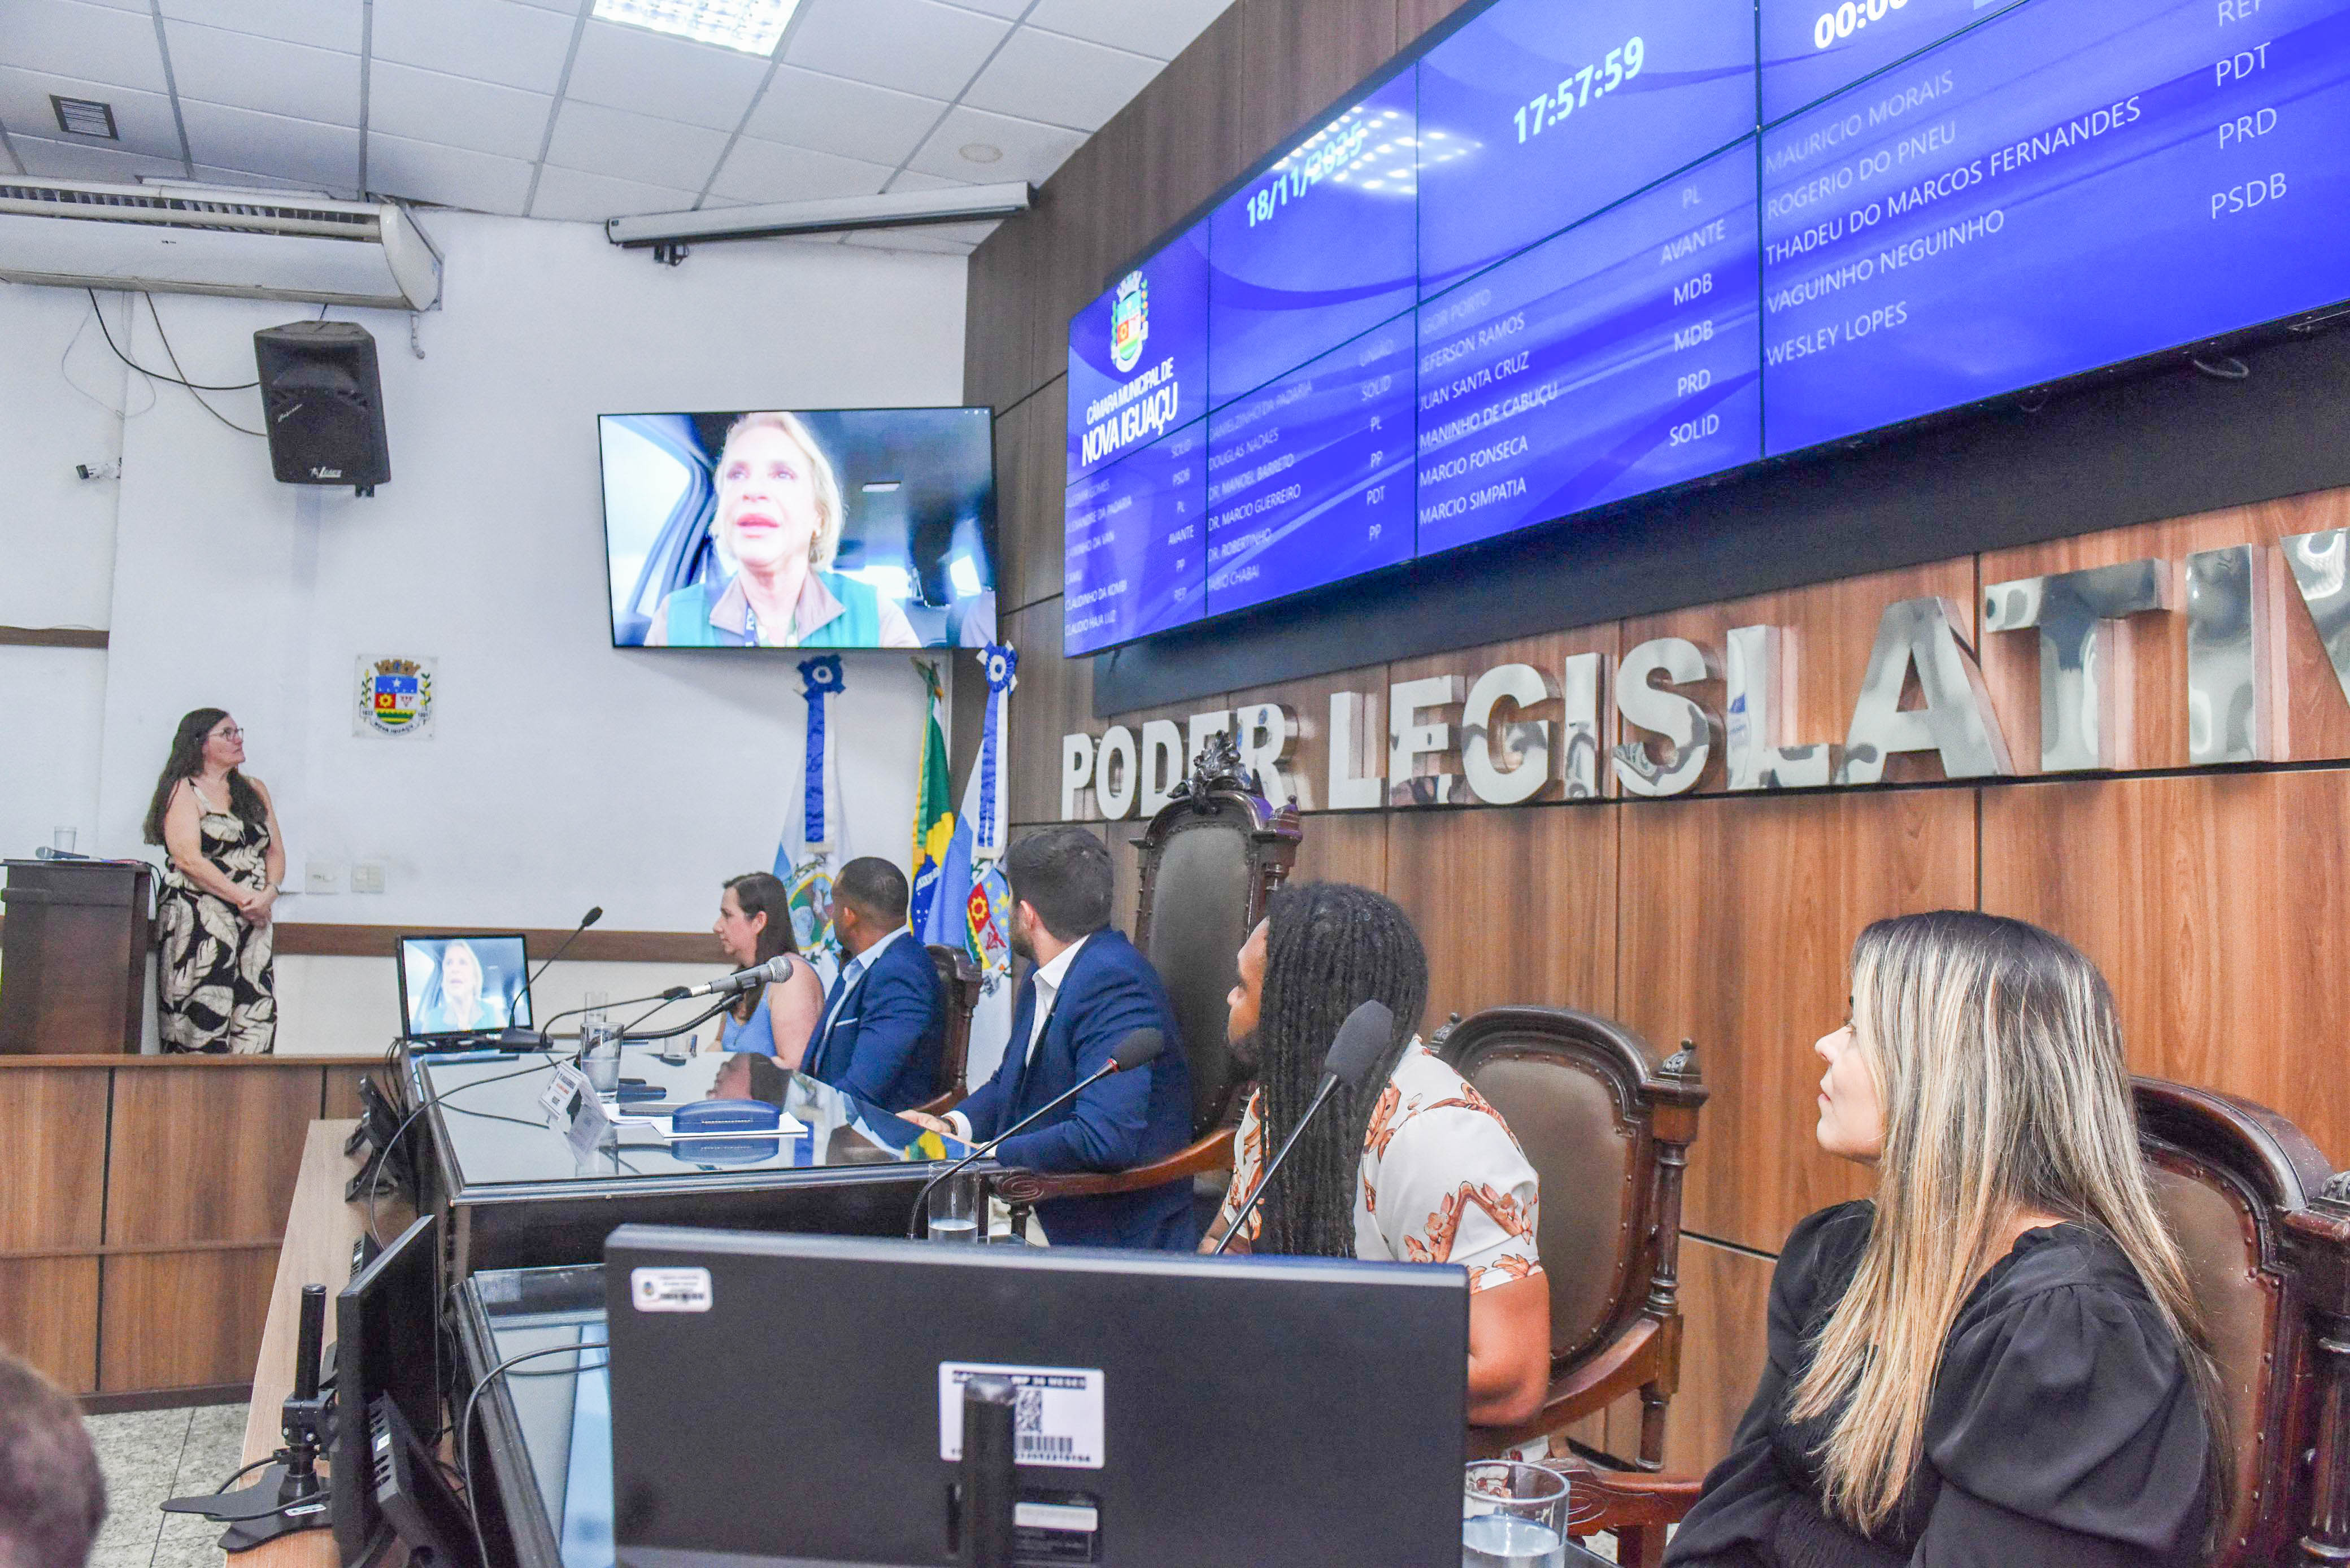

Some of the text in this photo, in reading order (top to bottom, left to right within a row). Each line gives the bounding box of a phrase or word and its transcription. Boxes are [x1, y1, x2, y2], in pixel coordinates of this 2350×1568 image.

[1814, 0, 1909, 49] 00:0
[2216, 41, 2271, 87] PDT
[1513, 36, 1644, 144] 17:57:59
[1765, 70, 1954, 176] MAURICIO MORAIS
[2218, 107, 2278, 150] PRD
[1766, 95, 2142, 267] THADEU DO MARCOS FERNANDES
[1767, 121, 1957, 221] ROGERIO DO PNEU
[1682, 186, 1701, 209] PL
[2210, 172, 2288, 220] PSDB
[1660, 218, 1726, 265] AVANTE
[1767, 209, 2005, 315] VAGUINHO NEGUINHO
[1674, 273, 1714, 306] MDB
[1478, 311, 1526, 347] RAMOS
[1674, 320, 1714, 352] MDB
[1766, 300, 1909, 368] WESLEY LOPES
[1161, 356, 1174, 382] DE
[1419, 350, 1530, 412] JUAN SANTA CRUZ
[1677, 369, 1712, 398] PRD
[1082, 381, 1178, 468] NOVA IGUAÇU
[1370, 415, 1383, 433] PL
[1420, 382, 1559, 450] MANINHO DE CABUÇU
[1669, 413, 1720, 447] SOLID
[1370, 450, 1383, 468] PP
[1420, 435, 1529, 489] MARCIO FONSECA
[1366, 485, 1386, 506] PDT
[1420, 477, 1527, 526] MARCIO SIMPATIA
[1369, 523, 1382, 542] PP
